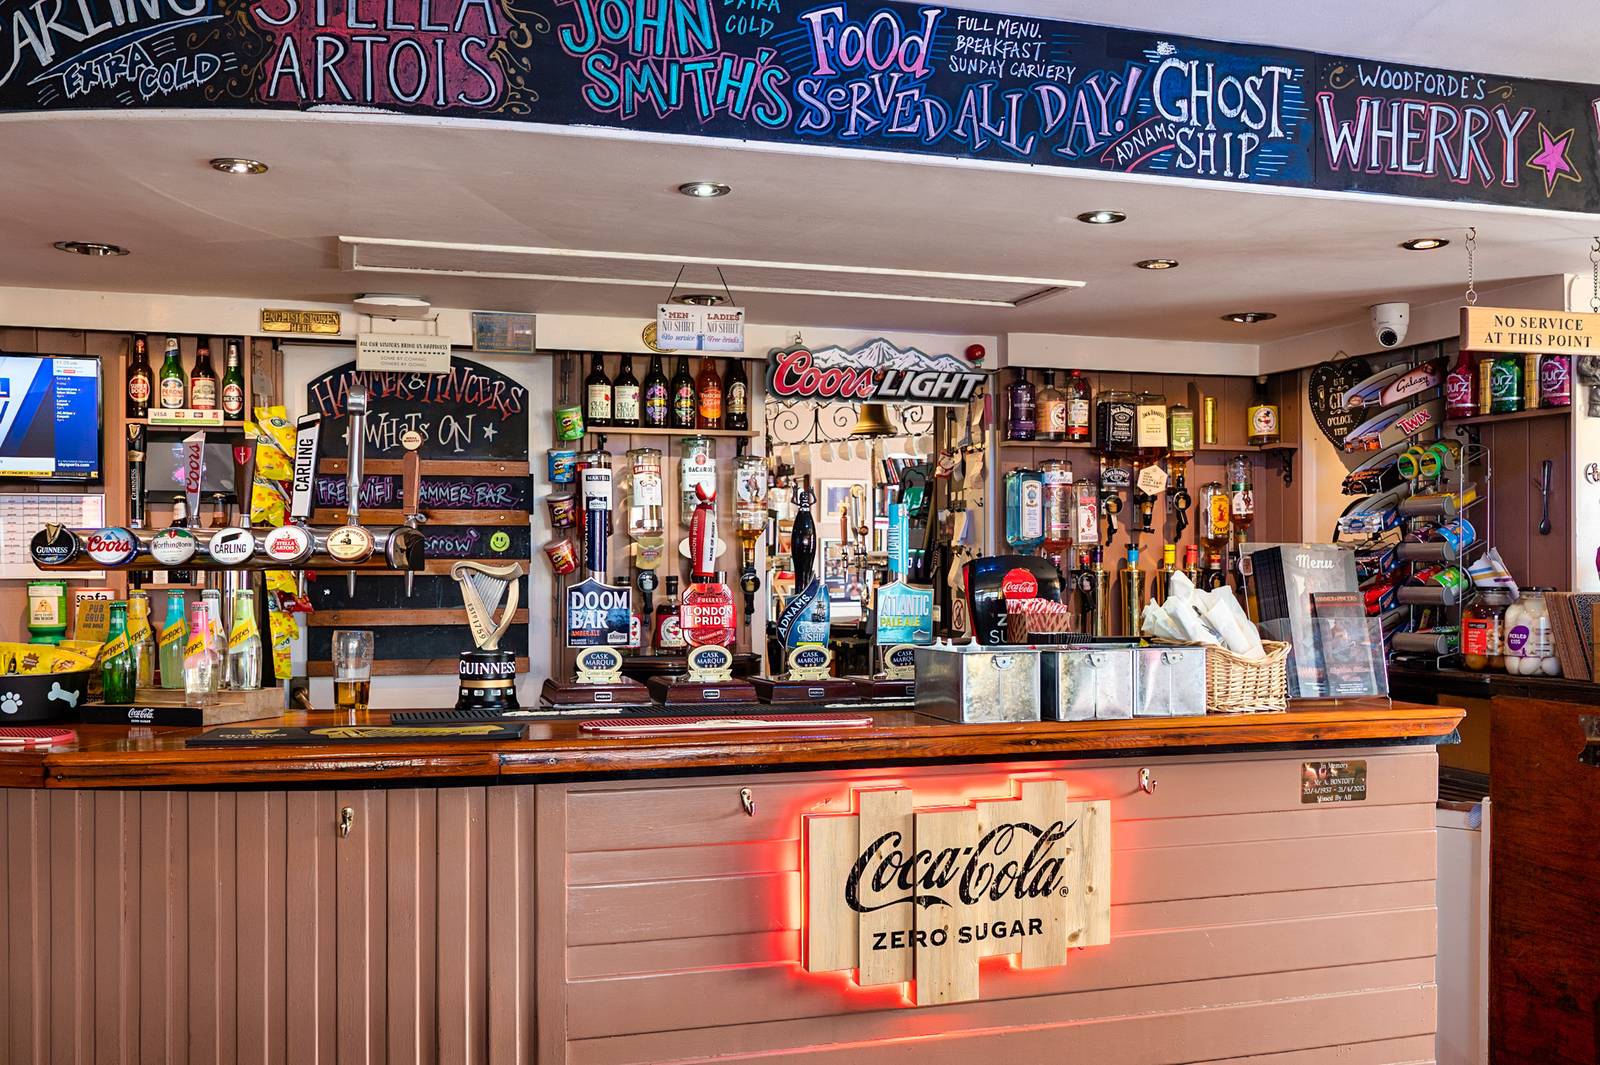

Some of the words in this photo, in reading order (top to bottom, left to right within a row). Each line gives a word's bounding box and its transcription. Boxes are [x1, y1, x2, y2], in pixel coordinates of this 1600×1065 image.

[560, 0, 717, 55] JOHN
[725, 15, 775, 38] COLD
[957, 16, 994, 32] FULL
[63, 42, 154, 99] EXTRA
[139, 53, 221, 100] COLD
[269, 36, 497, 106] ARTOIS
[949, 55, 1007, 78] SUNDAY
[584, 50, 790, 127] SMITH'S
[1358, 64, 1487, 101] WOODFORDE'S
[1153, 58, 1292, 138] GHOST
[953, 83, 1035, 155] ALL
[1034, 66, 1143, 156] DAY!
[1115, 123, 1177, 165] ADNAMS
[1319, 95, 1531, 185] WHERRY
[1175, 127, 1259, 179] SHIP
[263, 311, 301, 323] ENGLISH
[662, 320, 673, 332] NO
[674, 321, 695, 333] SHIRT
[707, 313, 740, 321] LADIES
[1494, 315, 1515, 328] NO
[1520, 316, 1583, 331] SERVICE
[291, 323, 311, 332] HERE
[707, 321, 718, 333] NO
[719, 322, 738, 334] SHIRT
[1484, 332, 1503, 344] AT
[1508, 333, 1543, 346] THIS
[1548, 335, 1592, 348] POINT
[773, 349, 876, 398] Coors
[877, 370, 988, 399] LIGHT
[1396, 375, 1431, 393] Galaxy
[438, 413, 477, 453] ON
[186, 443, 200, 494] Coors
[295, 438, 314, 492] CARLING
[420, 484, 472, 500] AMMER
[475, 484, 513, 504] BAR
[36, 545, 68, 554] GUINNESS
[87, 536, 132, 553] Coors
[214, 543, 247, 554] CARLING
[1295, 554, 1335, 569] Menu
[1004, 581, 1035, 593] Coca-Cola
[88, 603, 105, 613] PUB
[571, 591, 628, 610] DOOM
[880, 594, 930, 616] ATLANTIC
[85, 613, 105, 622] GRUB
[571, 610, 609, 629] BAR
[687, 606, 733, 616] LONDON
[694, 616, 728, 625] PRIDE
[472, 619, 487, 640] 1759
[797, 622, 826, 634] GHOST
[879, 616, 903, 627] PALE
[902, 617, 922, 627] ALE
[459, 659, 516, 675] GUINNESS
[127, 707, 154, 719] Coca-Cola
[845, 817, 1078, 913] Coca-Cola
[872, 928, 948, 951] ZERO
[958, 918, 1044, 945] SUGAR
